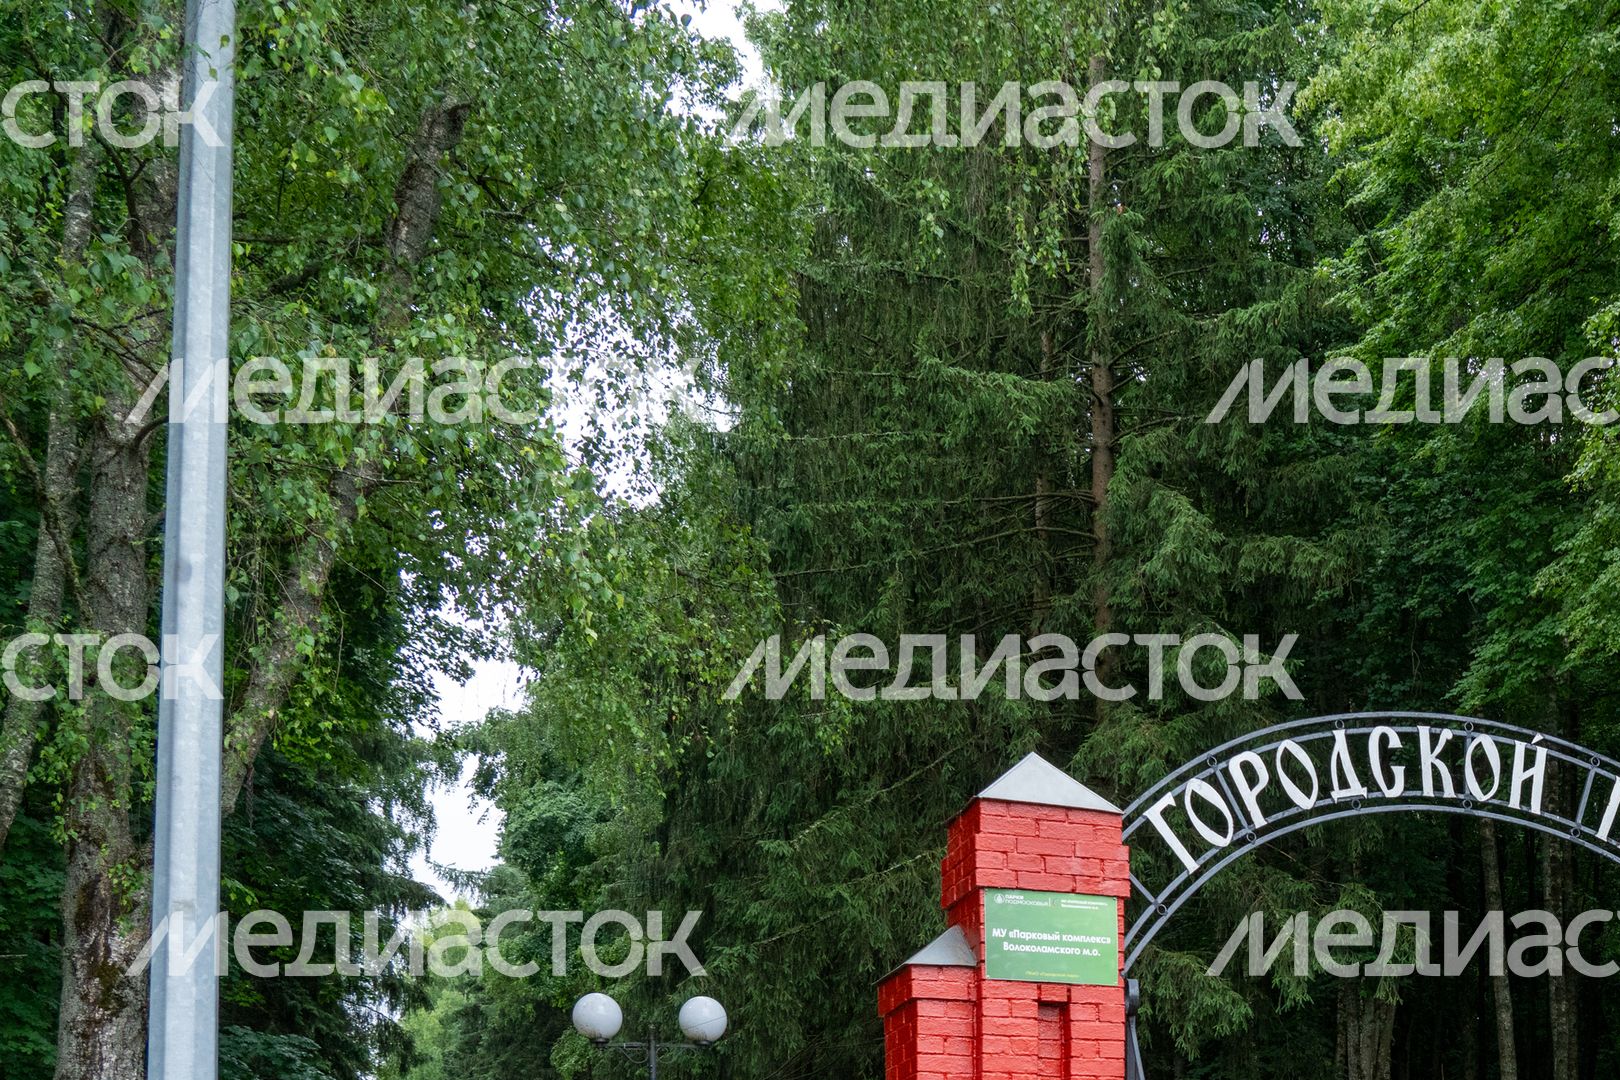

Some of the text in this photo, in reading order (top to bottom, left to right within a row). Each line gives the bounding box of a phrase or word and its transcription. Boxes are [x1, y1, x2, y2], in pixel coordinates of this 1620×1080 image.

[992, 928, 1111, 944] МУ «Парковый комплекс»
[1003, 941, 1101, 957] Волоколамского м.о.
